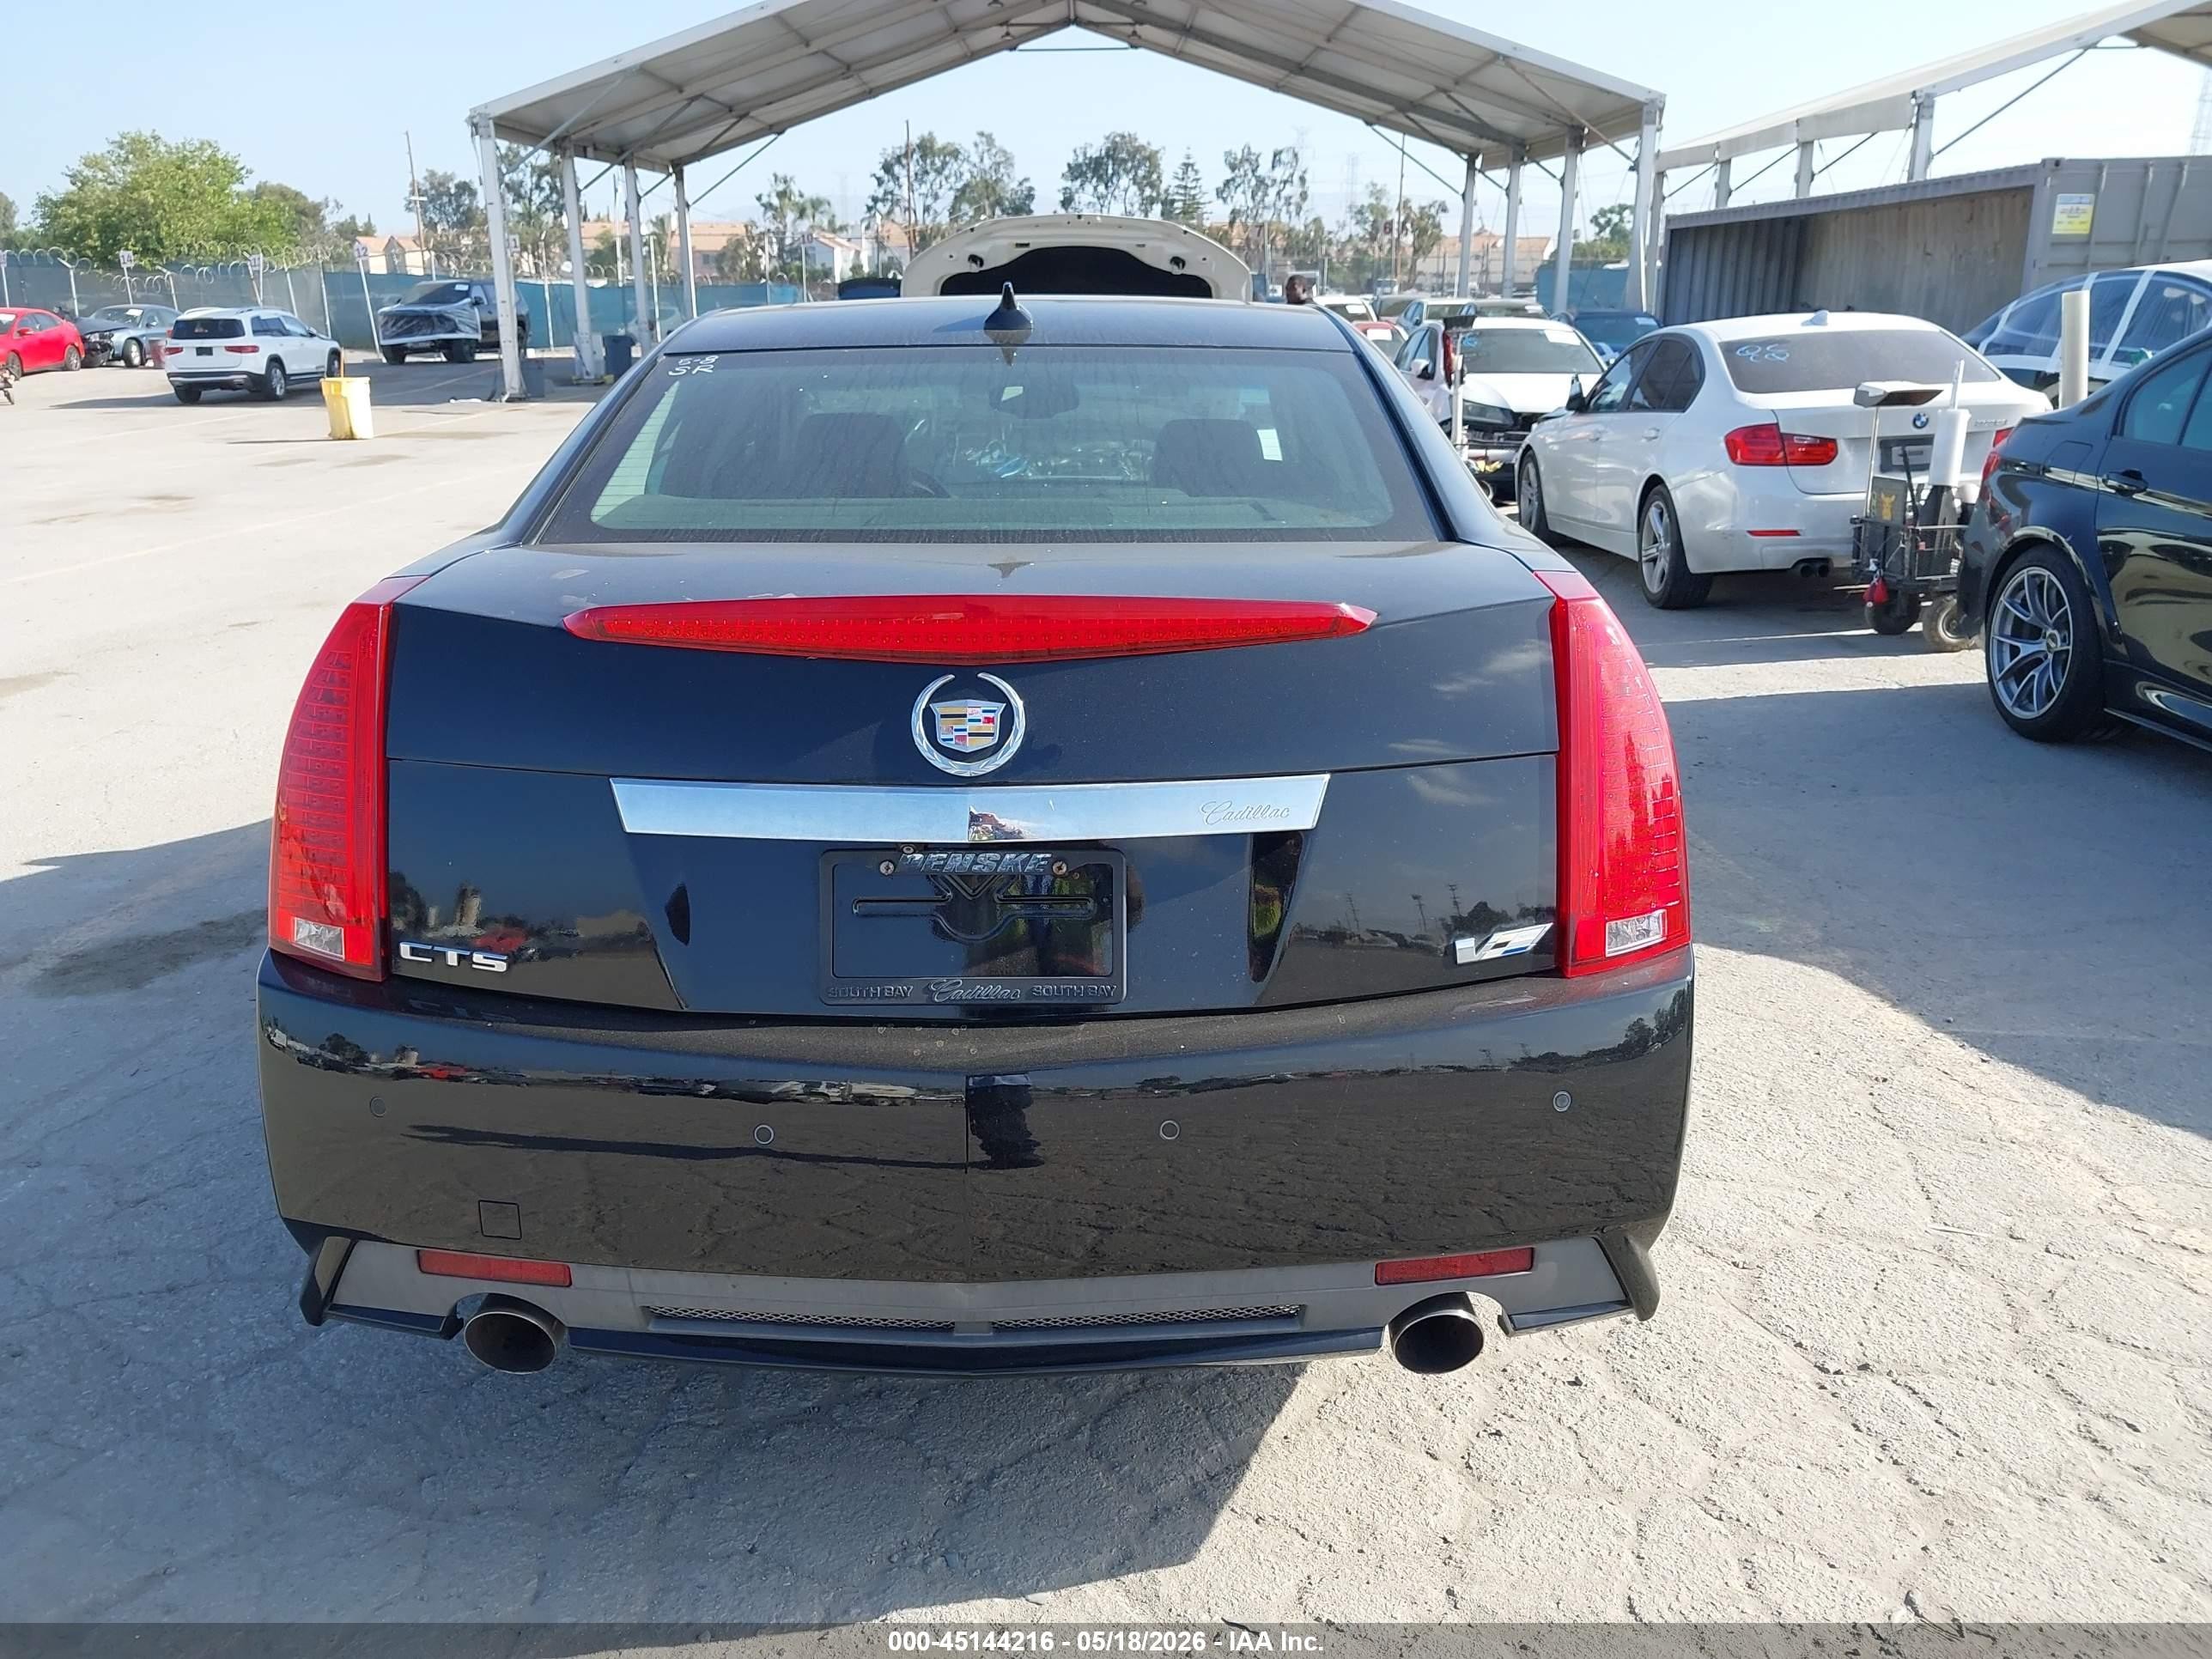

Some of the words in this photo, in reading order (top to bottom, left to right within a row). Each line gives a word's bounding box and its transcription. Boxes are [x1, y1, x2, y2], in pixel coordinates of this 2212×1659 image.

[356, 246, 368, 258] 12
[121, 253, 132, 264] 14
[668, 364, 714, 376] SR
[1201, 800, 1290, 825] Cadillac
[399, 941, 508, 973] CTS
[884, 985, 914, 998] BAY
[929, 979, 1021, 1003] Cadillac
[1032, 985, 1085, 997] SOUTH
[1087, 985, 1117, 997] BAY
